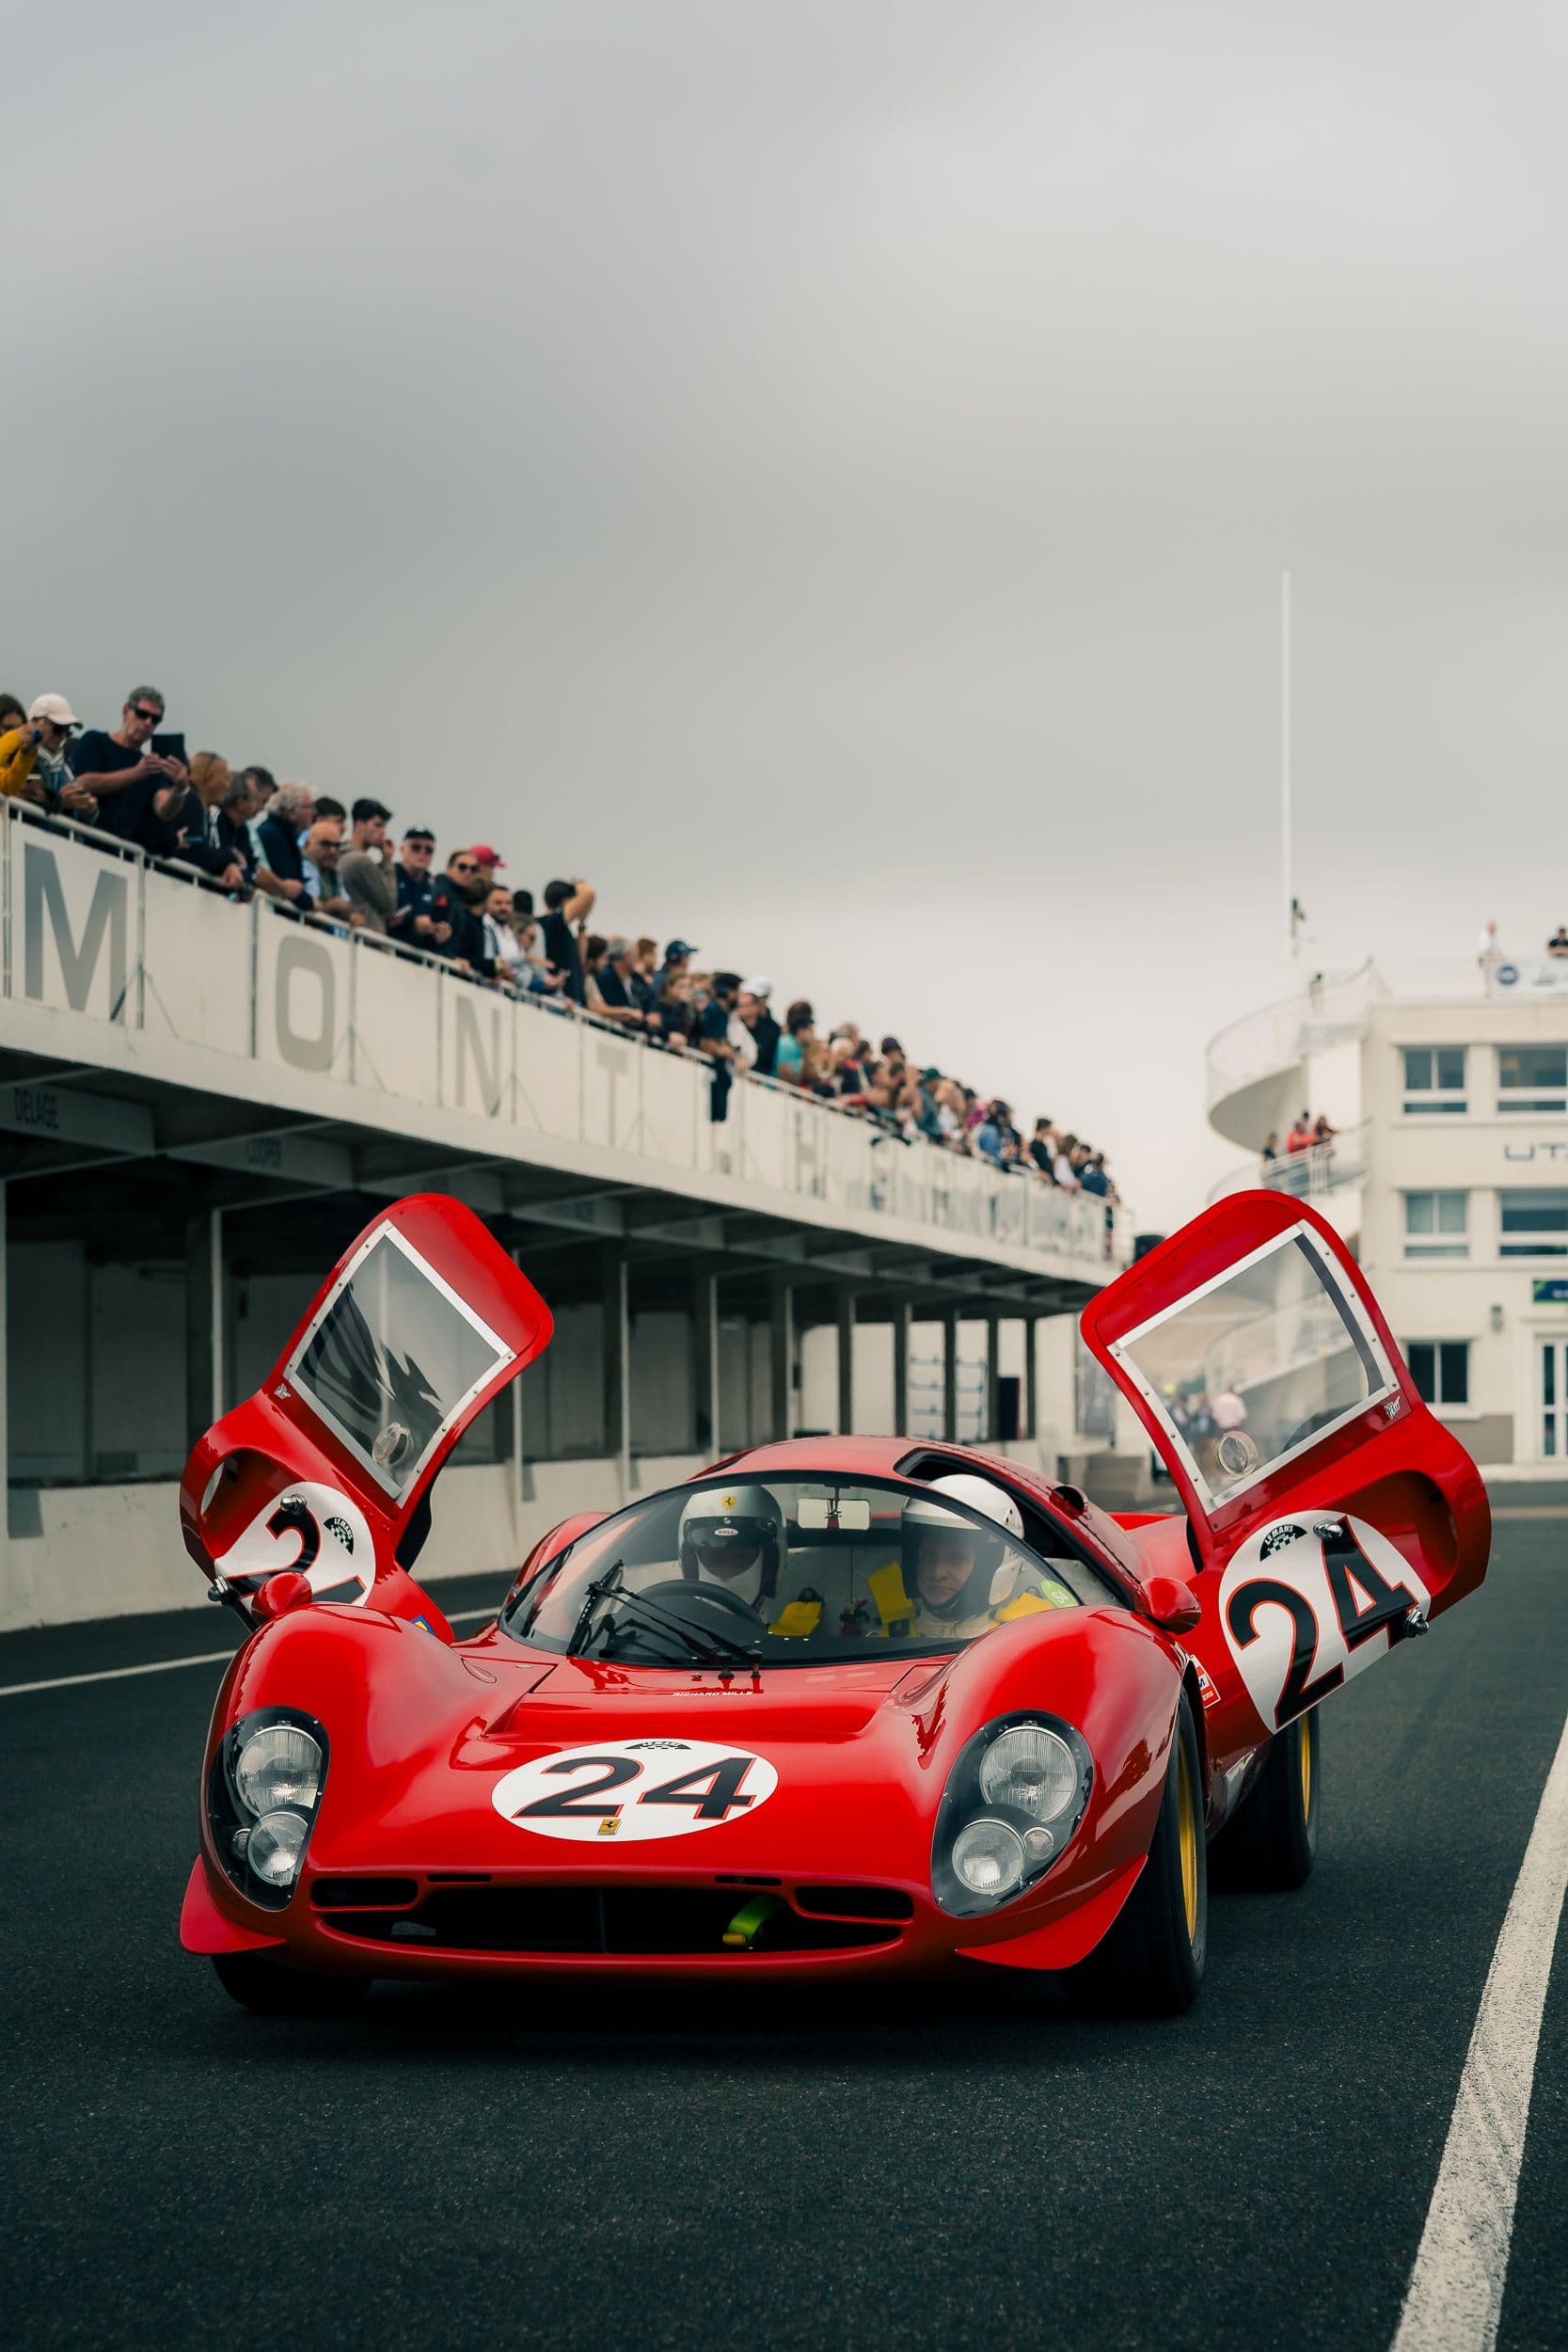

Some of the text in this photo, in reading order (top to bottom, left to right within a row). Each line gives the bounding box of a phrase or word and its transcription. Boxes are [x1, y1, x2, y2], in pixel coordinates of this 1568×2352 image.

[1504, 1141, 1568, 1162] UT
[1226, 1514, 1418, 1729] 24
[511, 1756, 757, 1820] 24
